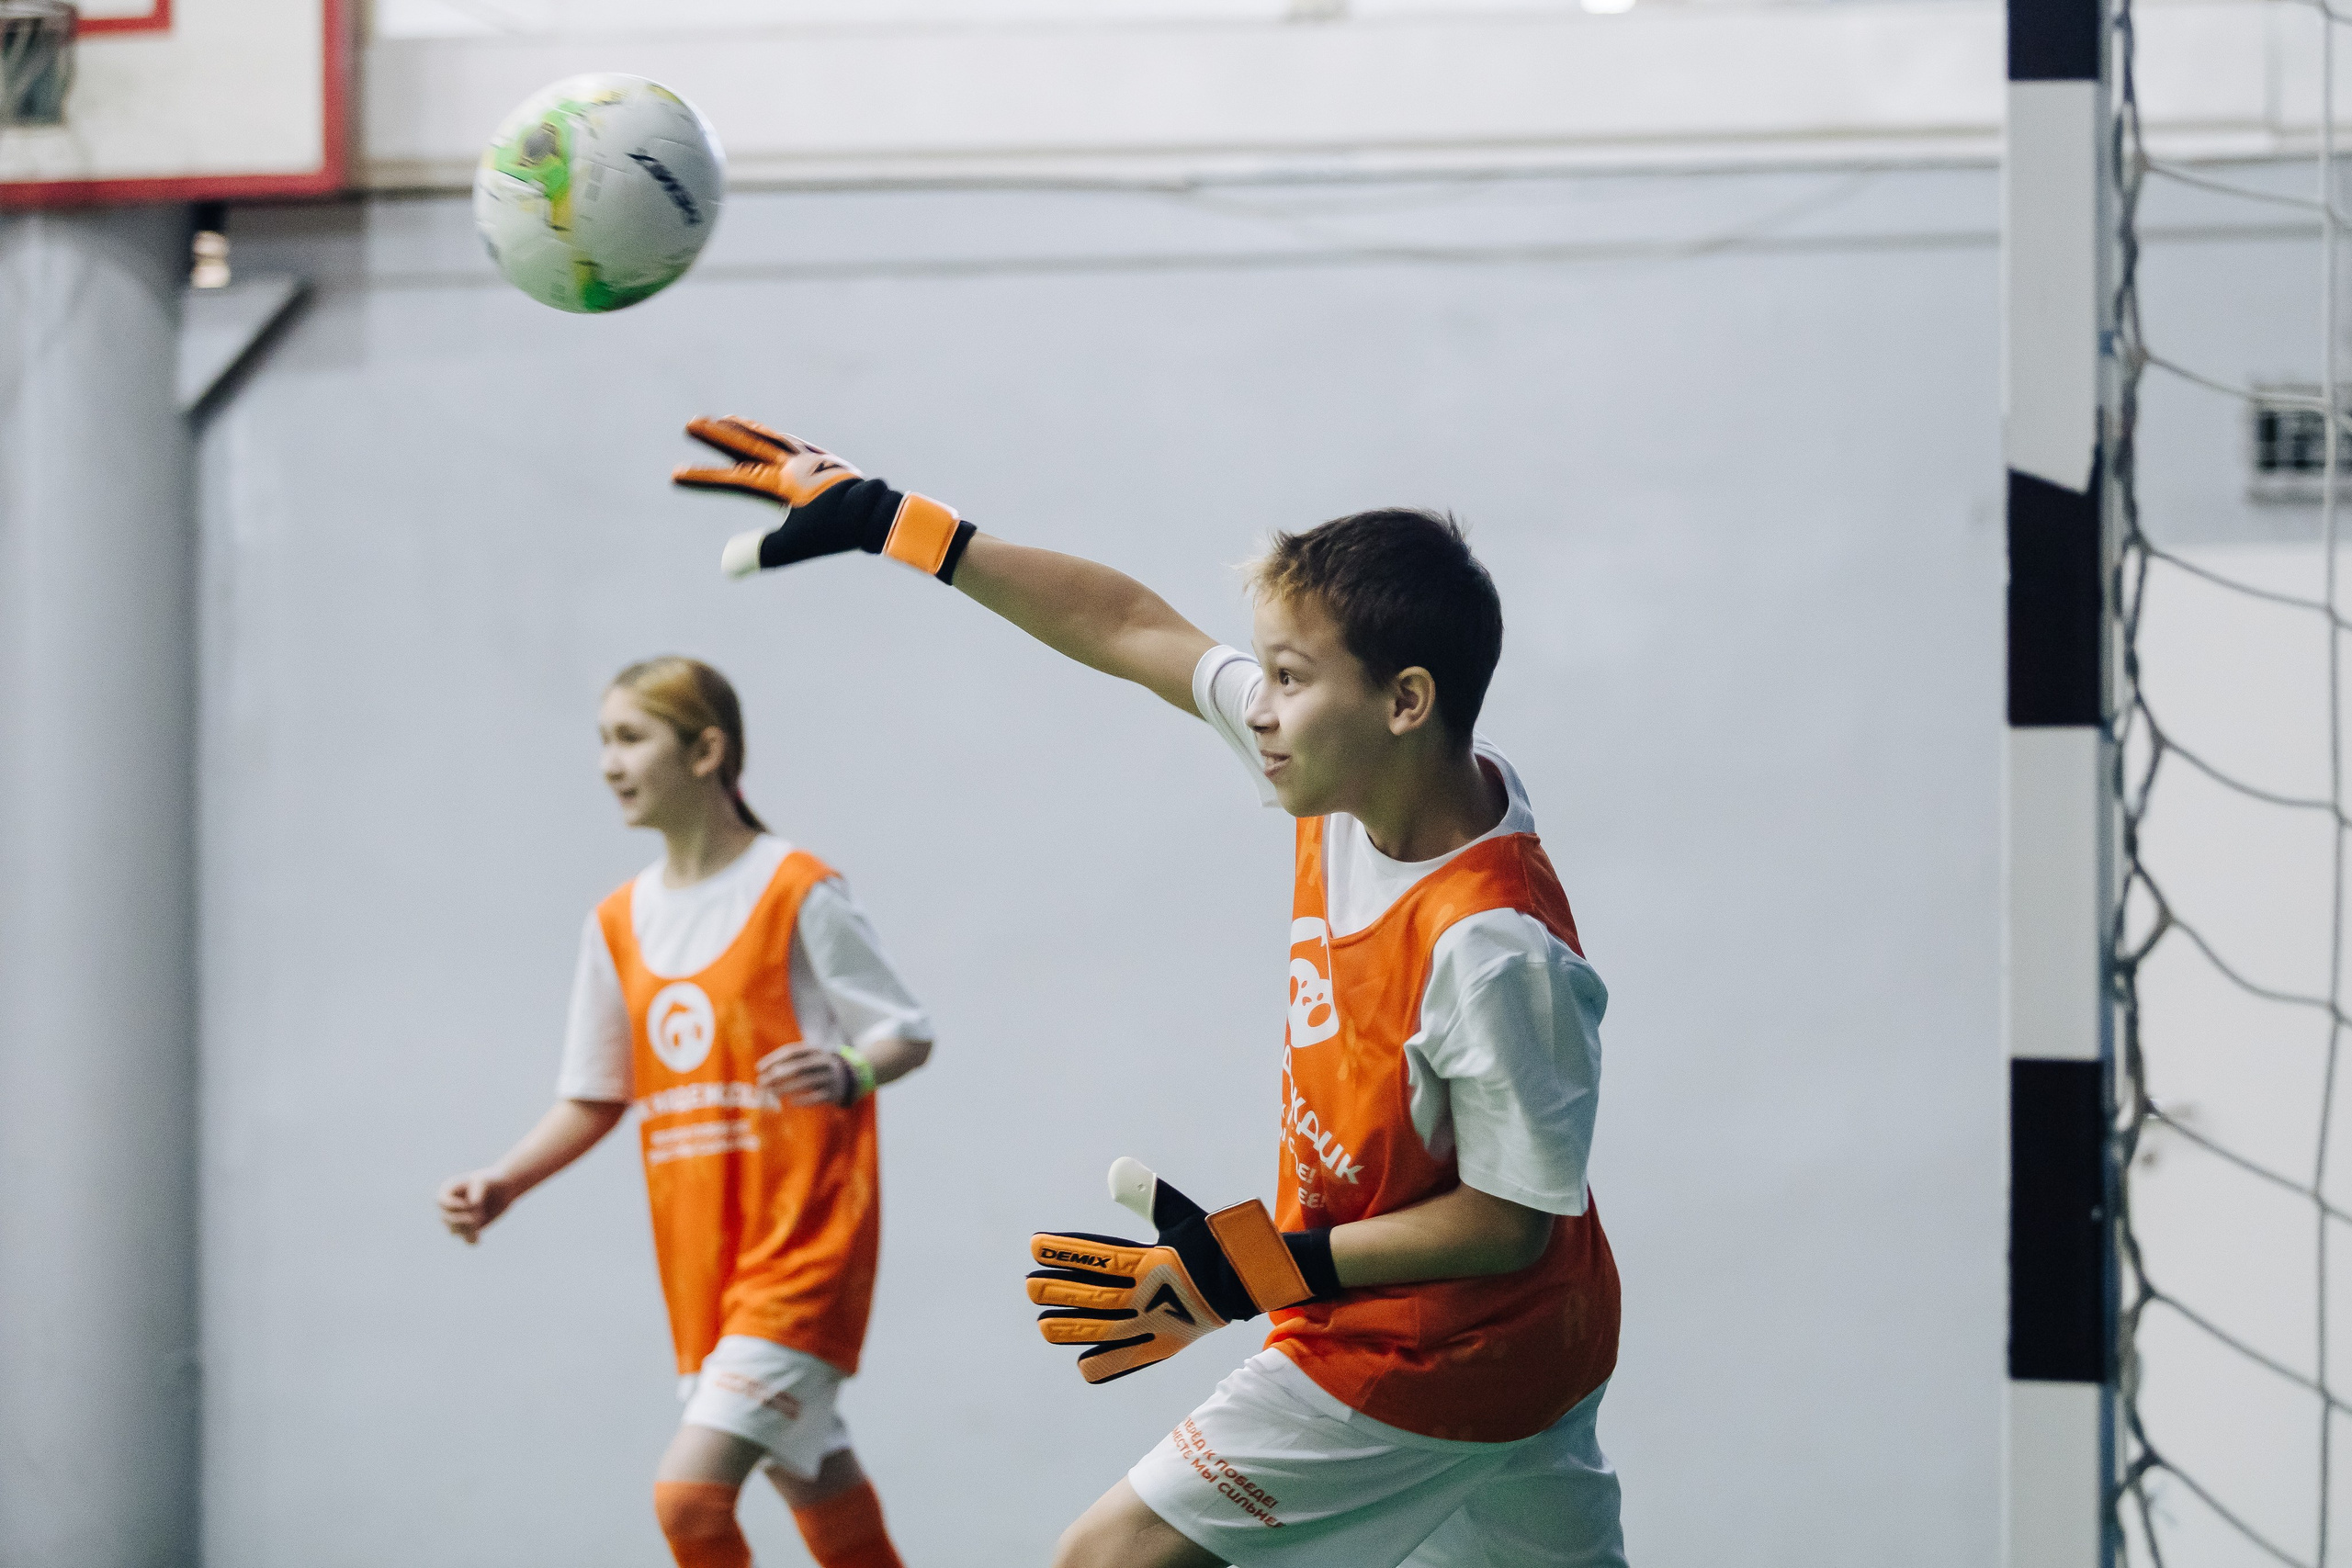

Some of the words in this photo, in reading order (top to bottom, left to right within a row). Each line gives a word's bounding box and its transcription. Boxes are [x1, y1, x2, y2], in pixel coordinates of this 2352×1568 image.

[1040, 1247, 1112, 1269] DEMIX
[1172, 1427, 1193, 1460] МЕСТЕ
[1191, 1457, 1219, 1483] МЫ
[1203, 1449, 1216, 1461] К
[1214, 1459, 1279, 1509] ПОБЕДЕ!
